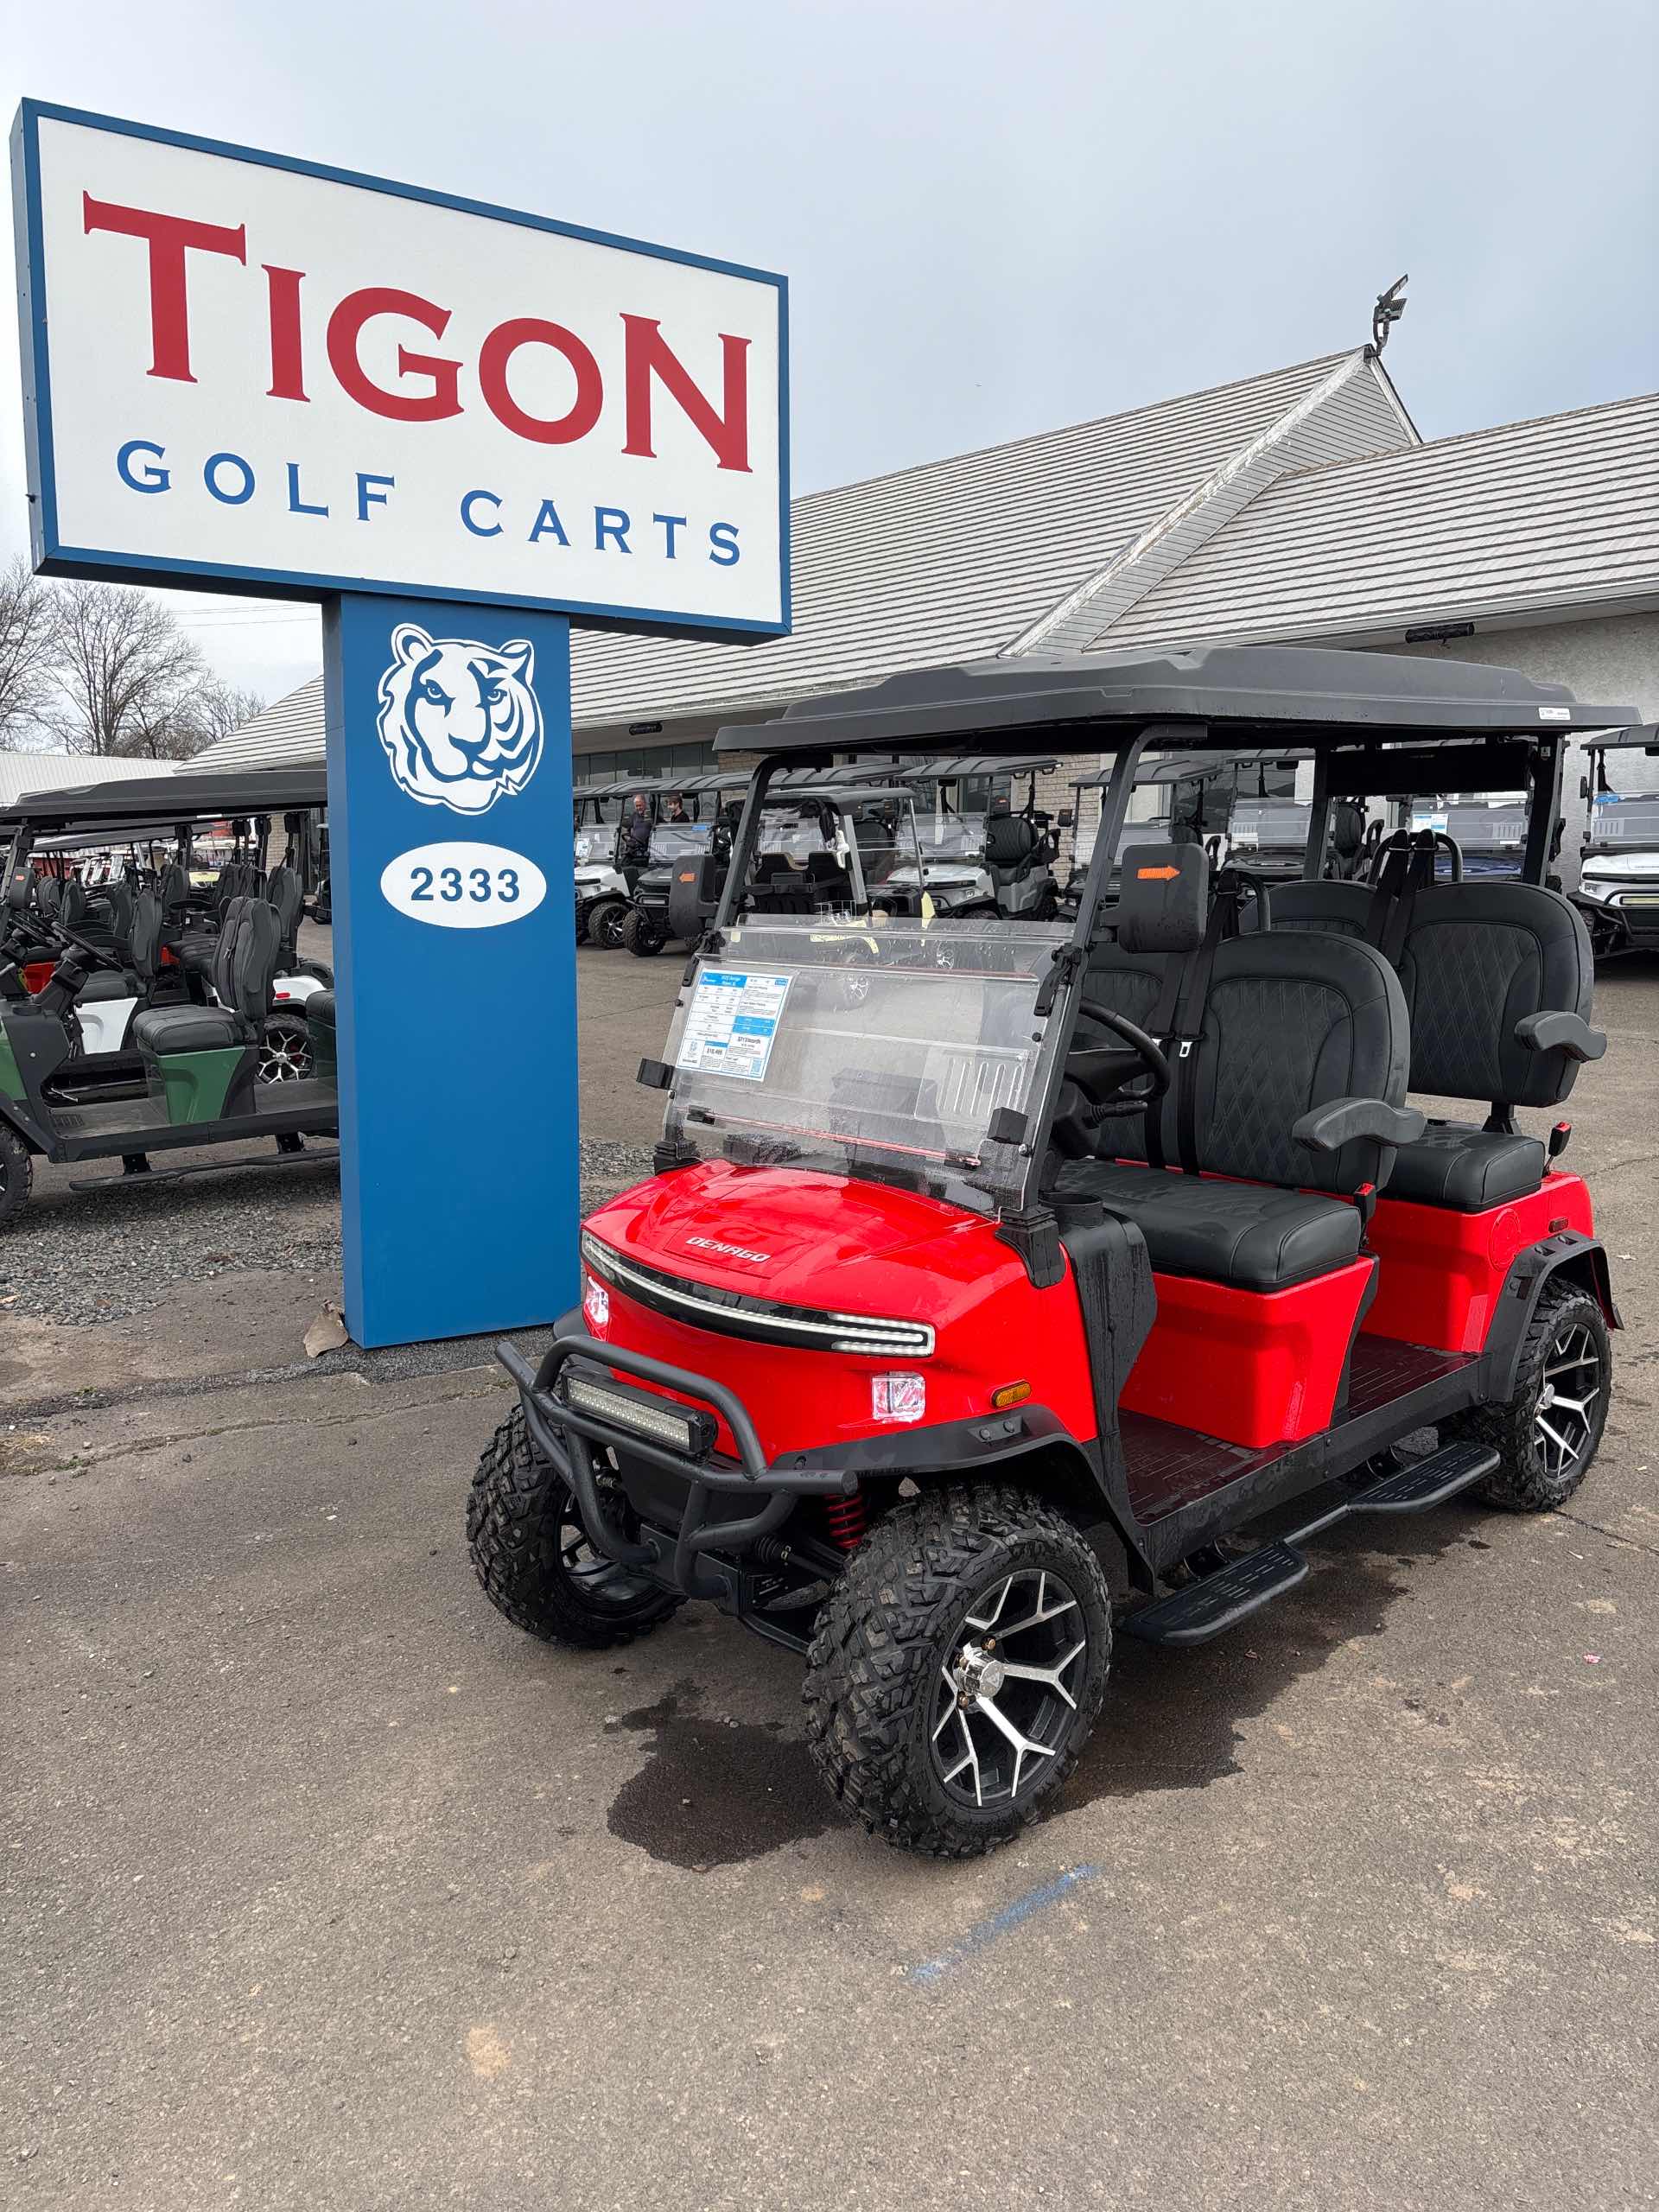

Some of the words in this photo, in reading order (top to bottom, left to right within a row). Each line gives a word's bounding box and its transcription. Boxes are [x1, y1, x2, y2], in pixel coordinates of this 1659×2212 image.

[83, 190, 753, 473] TIGON
[118, 441, 395, 521] GOLF
[461, 489, 741, 567] CARTS
[410, 867, 519, 903] 2333
[685, 1236, 772, 1263] DENAGO
